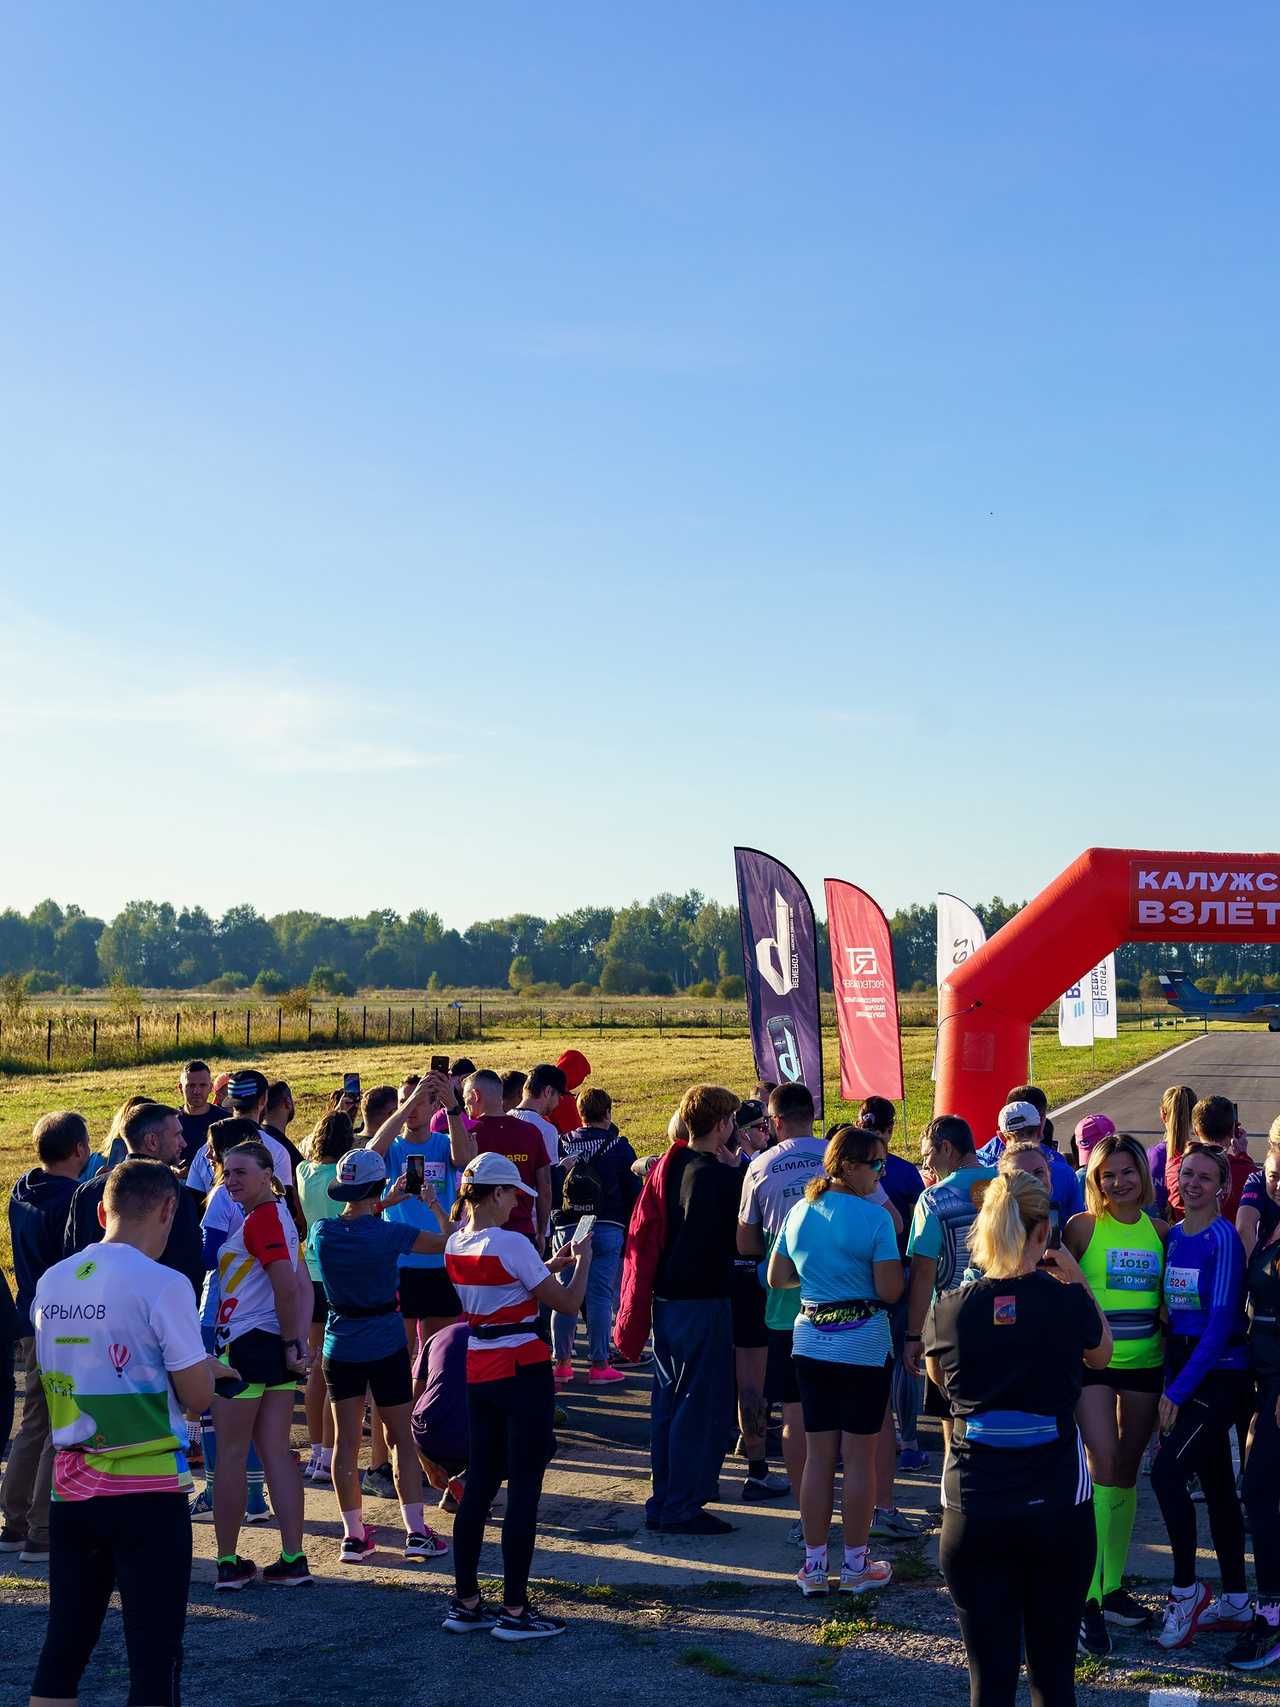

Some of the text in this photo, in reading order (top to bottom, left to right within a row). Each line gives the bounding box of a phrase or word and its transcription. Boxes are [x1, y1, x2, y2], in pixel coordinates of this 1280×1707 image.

[1120, 1259, 1150, 1269] 1019
[1123, 1275, 1133, 1284] 10
[1169, 1278, 1187, 1288] 524
[41, 1304, 106, 1320] КРЫЛОВ
